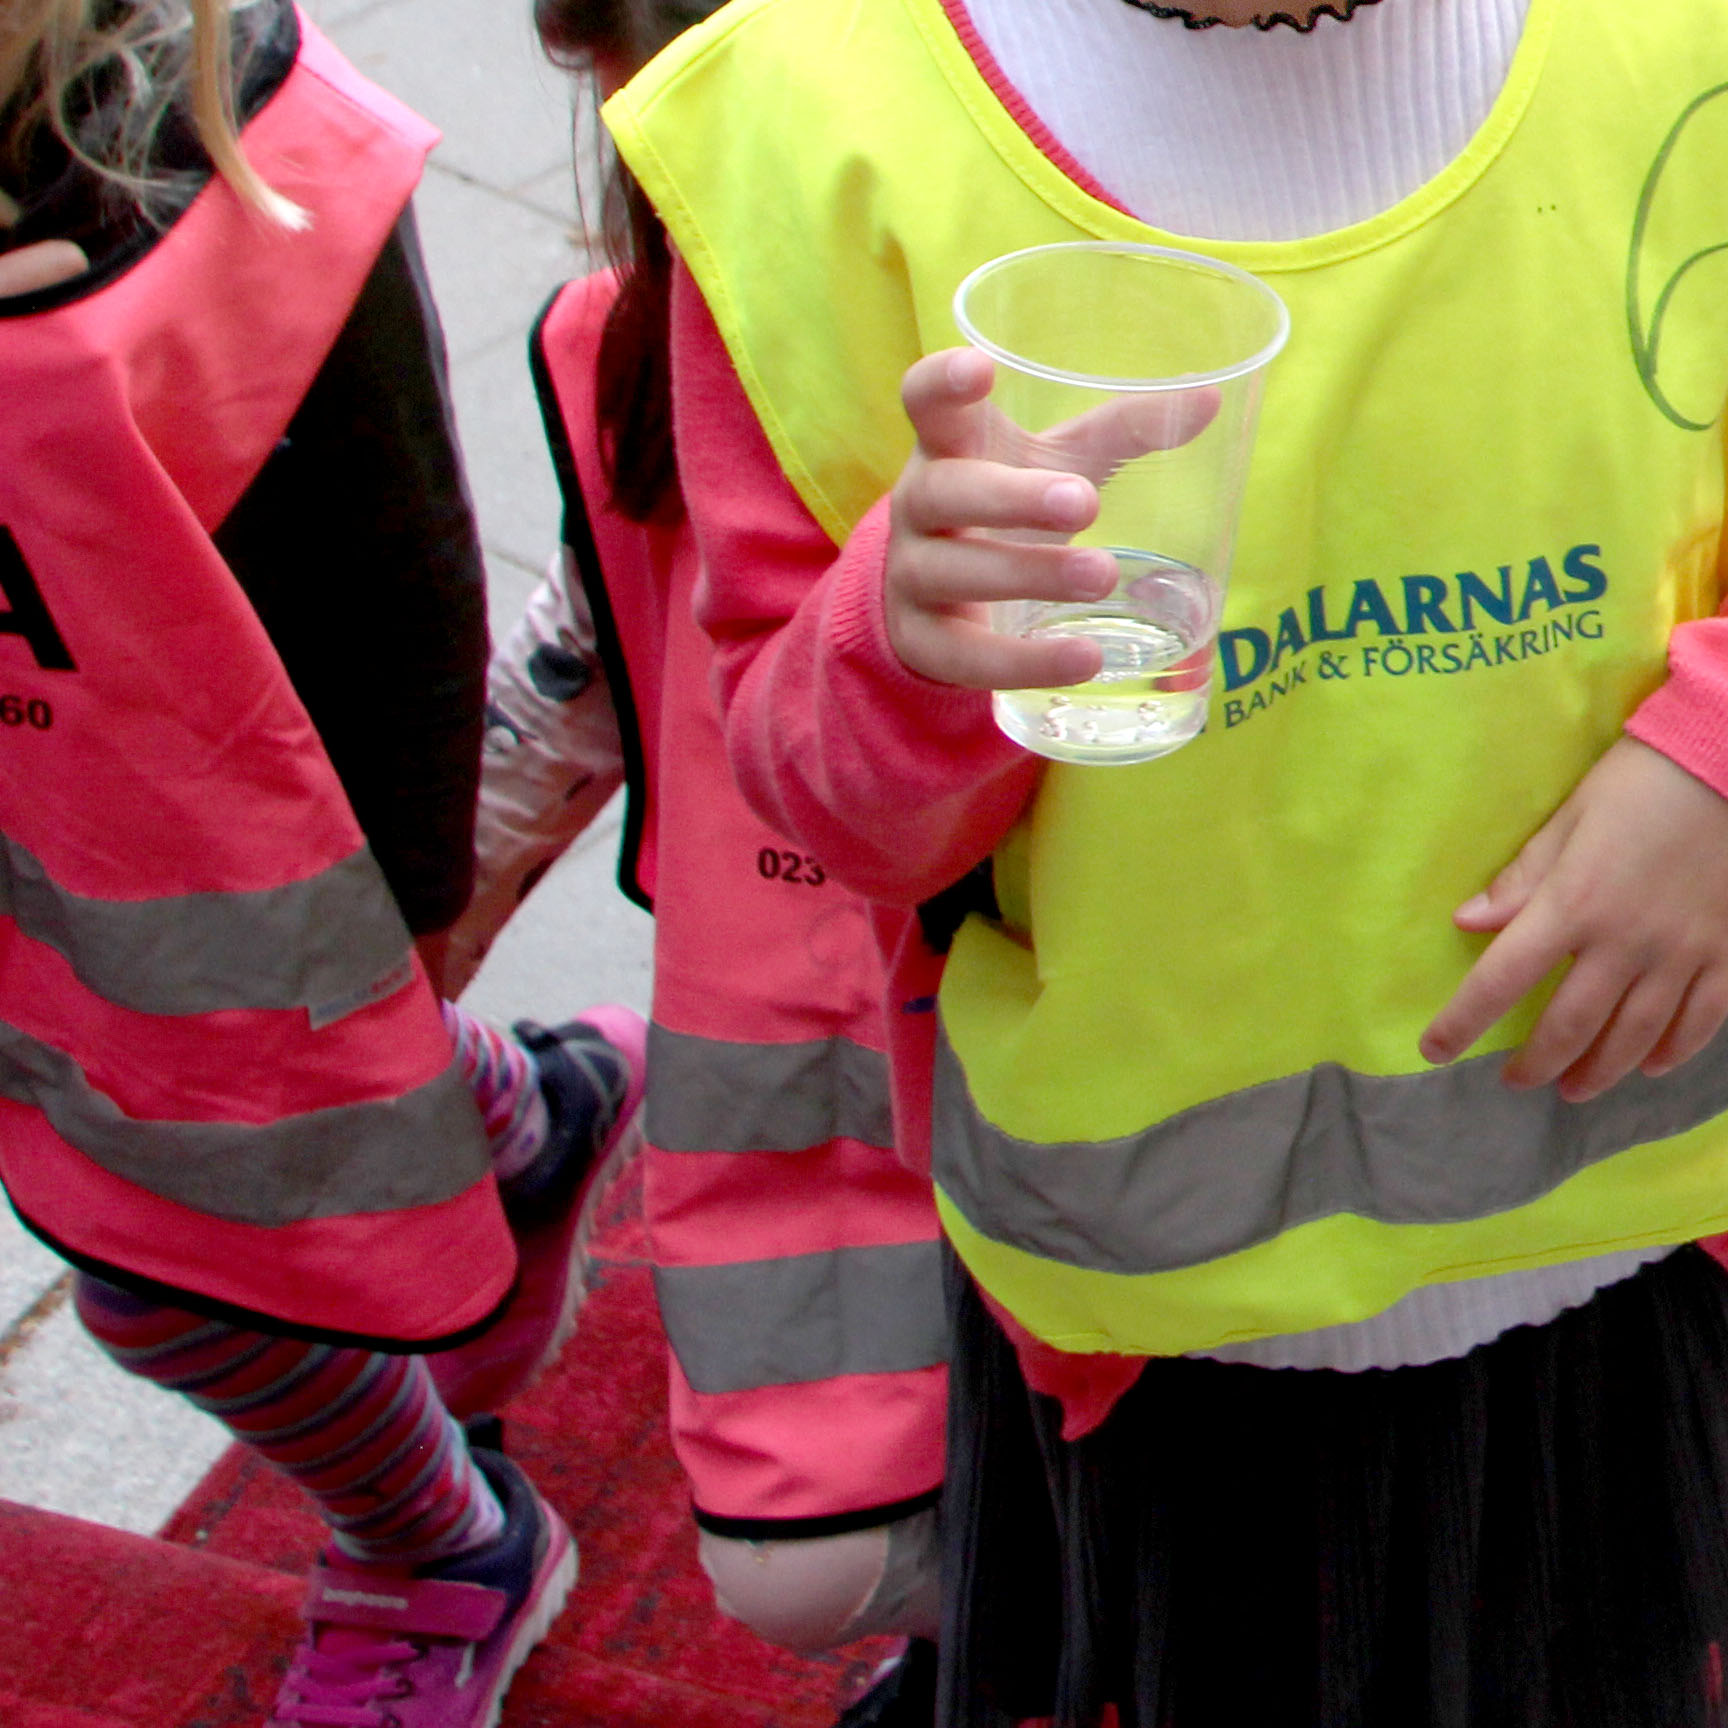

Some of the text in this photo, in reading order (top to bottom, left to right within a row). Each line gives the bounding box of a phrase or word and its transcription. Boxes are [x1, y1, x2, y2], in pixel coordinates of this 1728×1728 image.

[1218, 543, 1608, 693] DALARNAS
[1223, 608, 1605, 730] BANK & FÖRSÄKRING
